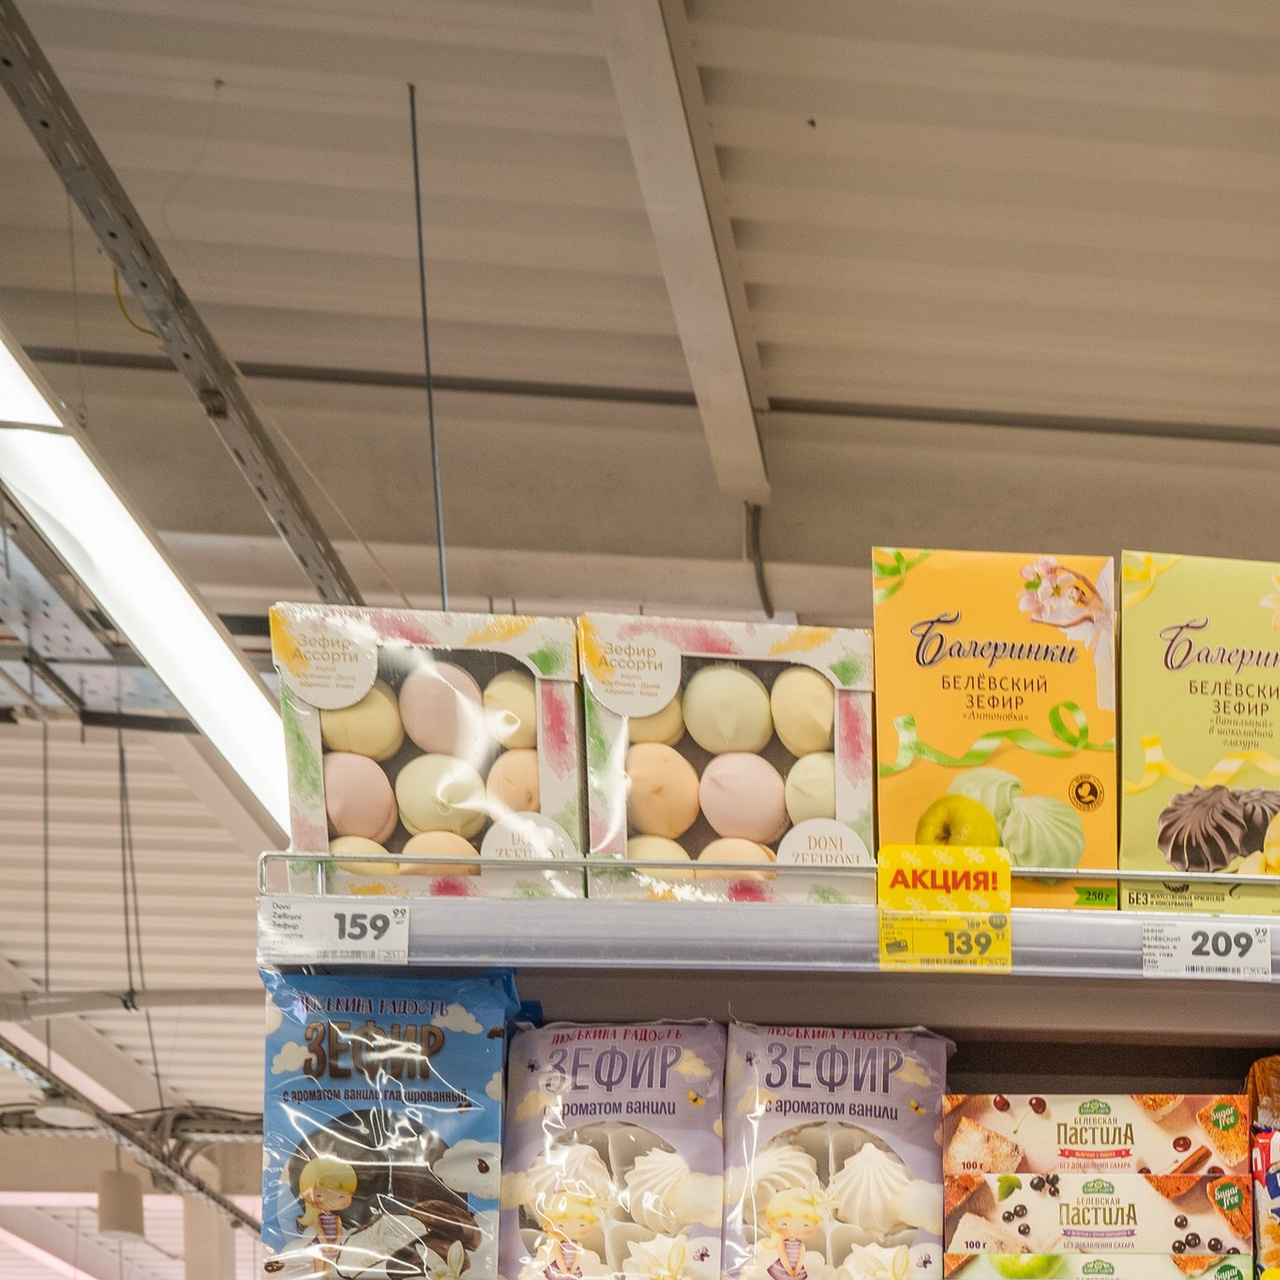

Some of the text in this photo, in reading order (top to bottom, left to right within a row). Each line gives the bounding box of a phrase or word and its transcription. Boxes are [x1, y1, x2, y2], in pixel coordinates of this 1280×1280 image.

[605, 642, 656, 657] Зефир
[911, 611, 1078, 669] Балеринки
[292, 649, 358, 664] Ассорти
[599, 657, 663, 671] Ассорти
[941, 674, 1048, 694] БЕЛЁВСКИЙ
[966, 694, 1024, 710] ЗЕФИР
[1213, 700, 1269, 716] ЗЕФИР
[808, 836, 844, 850] DONI
[890, 868, 999, 893] АКЦИЯ!
[334, 908, 406, 941] 159 99
[945, 930, 992, 955] 139
[1191, 928, 1267, 958] 209 99
[303, 1023, 443, 1080] ЗЕФИР
[544, 1044, 682, 1093] ЗЕФИР
[765, 1041, 905, 1094] ЗЕФИР
[626, 1102, 676, 1116] ванили
[775, 1100, 845, 1117] ароматом
[849, 1102, 898, 1120] ванили
[1074, 1117, 1117, 1125] БЕЛЕВСКАЯ
[1076, 1197, 1120, 1205] БЕЛЕВСКАЯ
